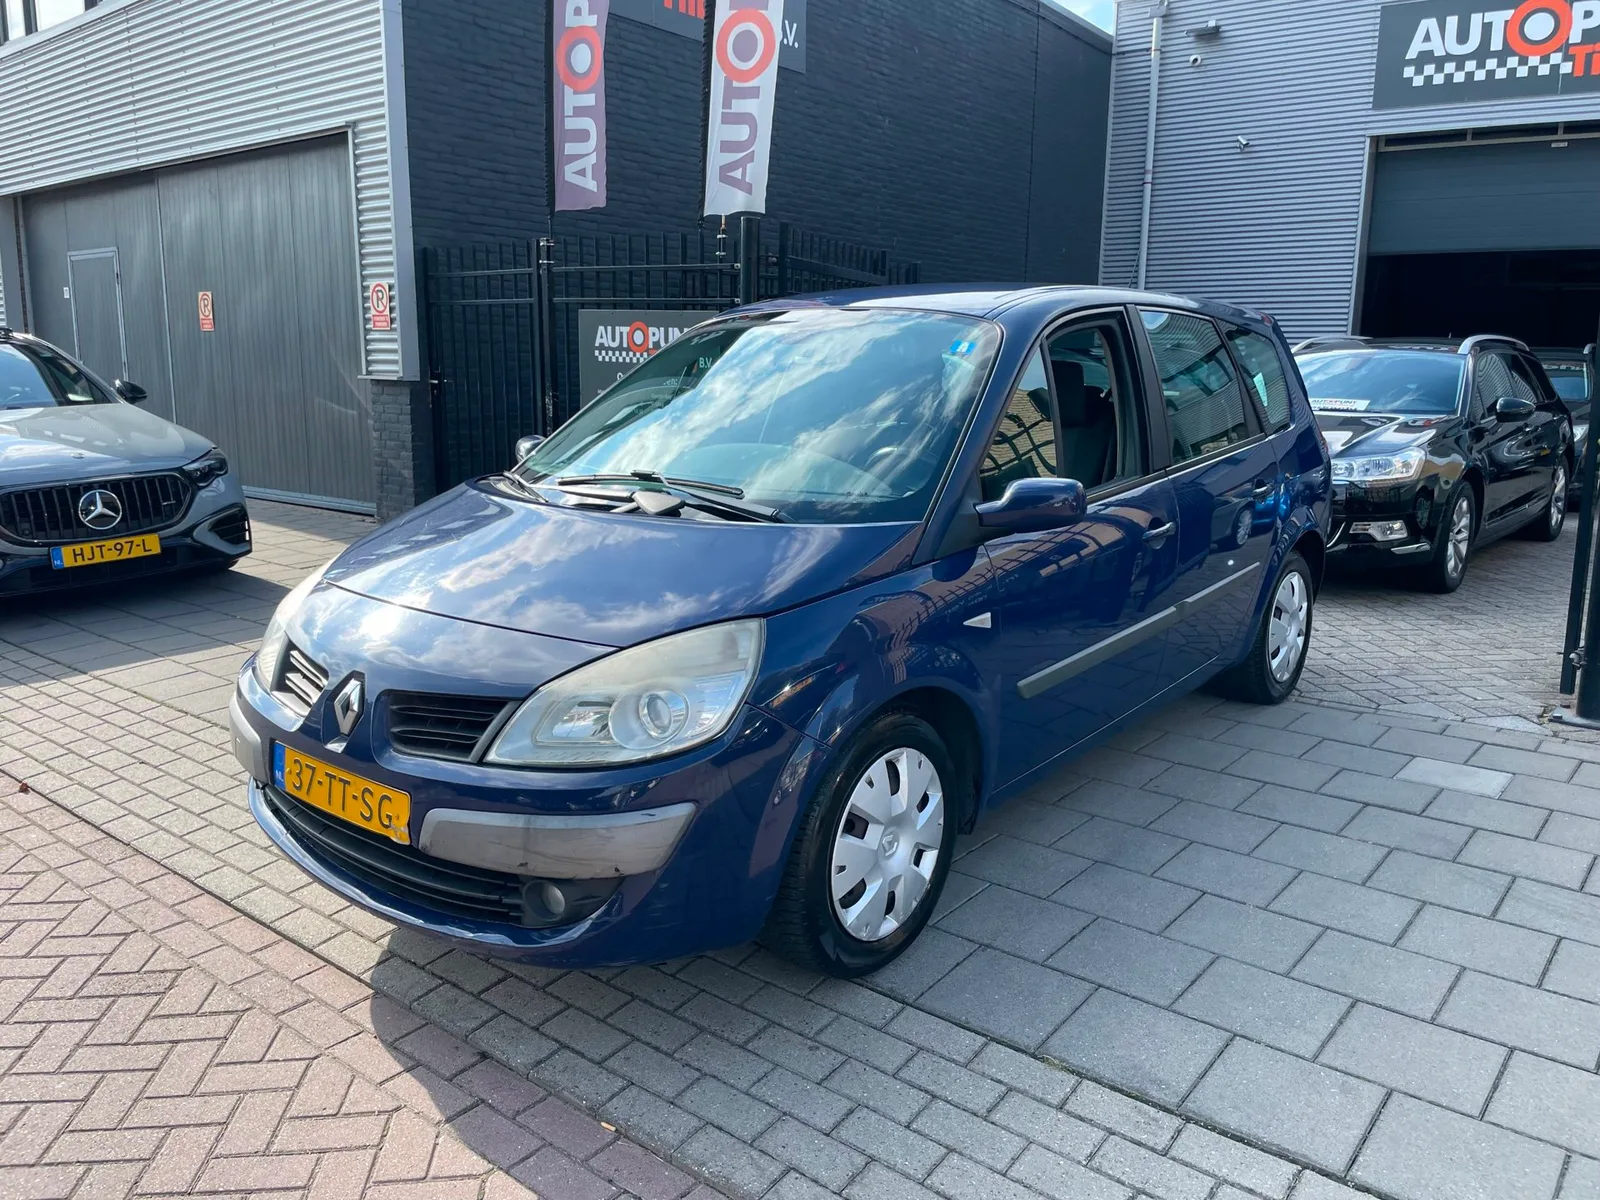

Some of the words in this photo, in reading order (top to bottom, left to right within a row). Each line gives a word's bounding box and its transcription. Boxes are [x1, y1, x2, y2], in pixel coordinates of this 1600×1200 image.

[782, 20, 799, 49] .V.
[594, 321, 691, 354] AUTOPUN
[72, 538, 152, 563] HJT-97-L
[275, 769, 284, 782] NL
[292, 757, 393, 829] 37-TT-SG
